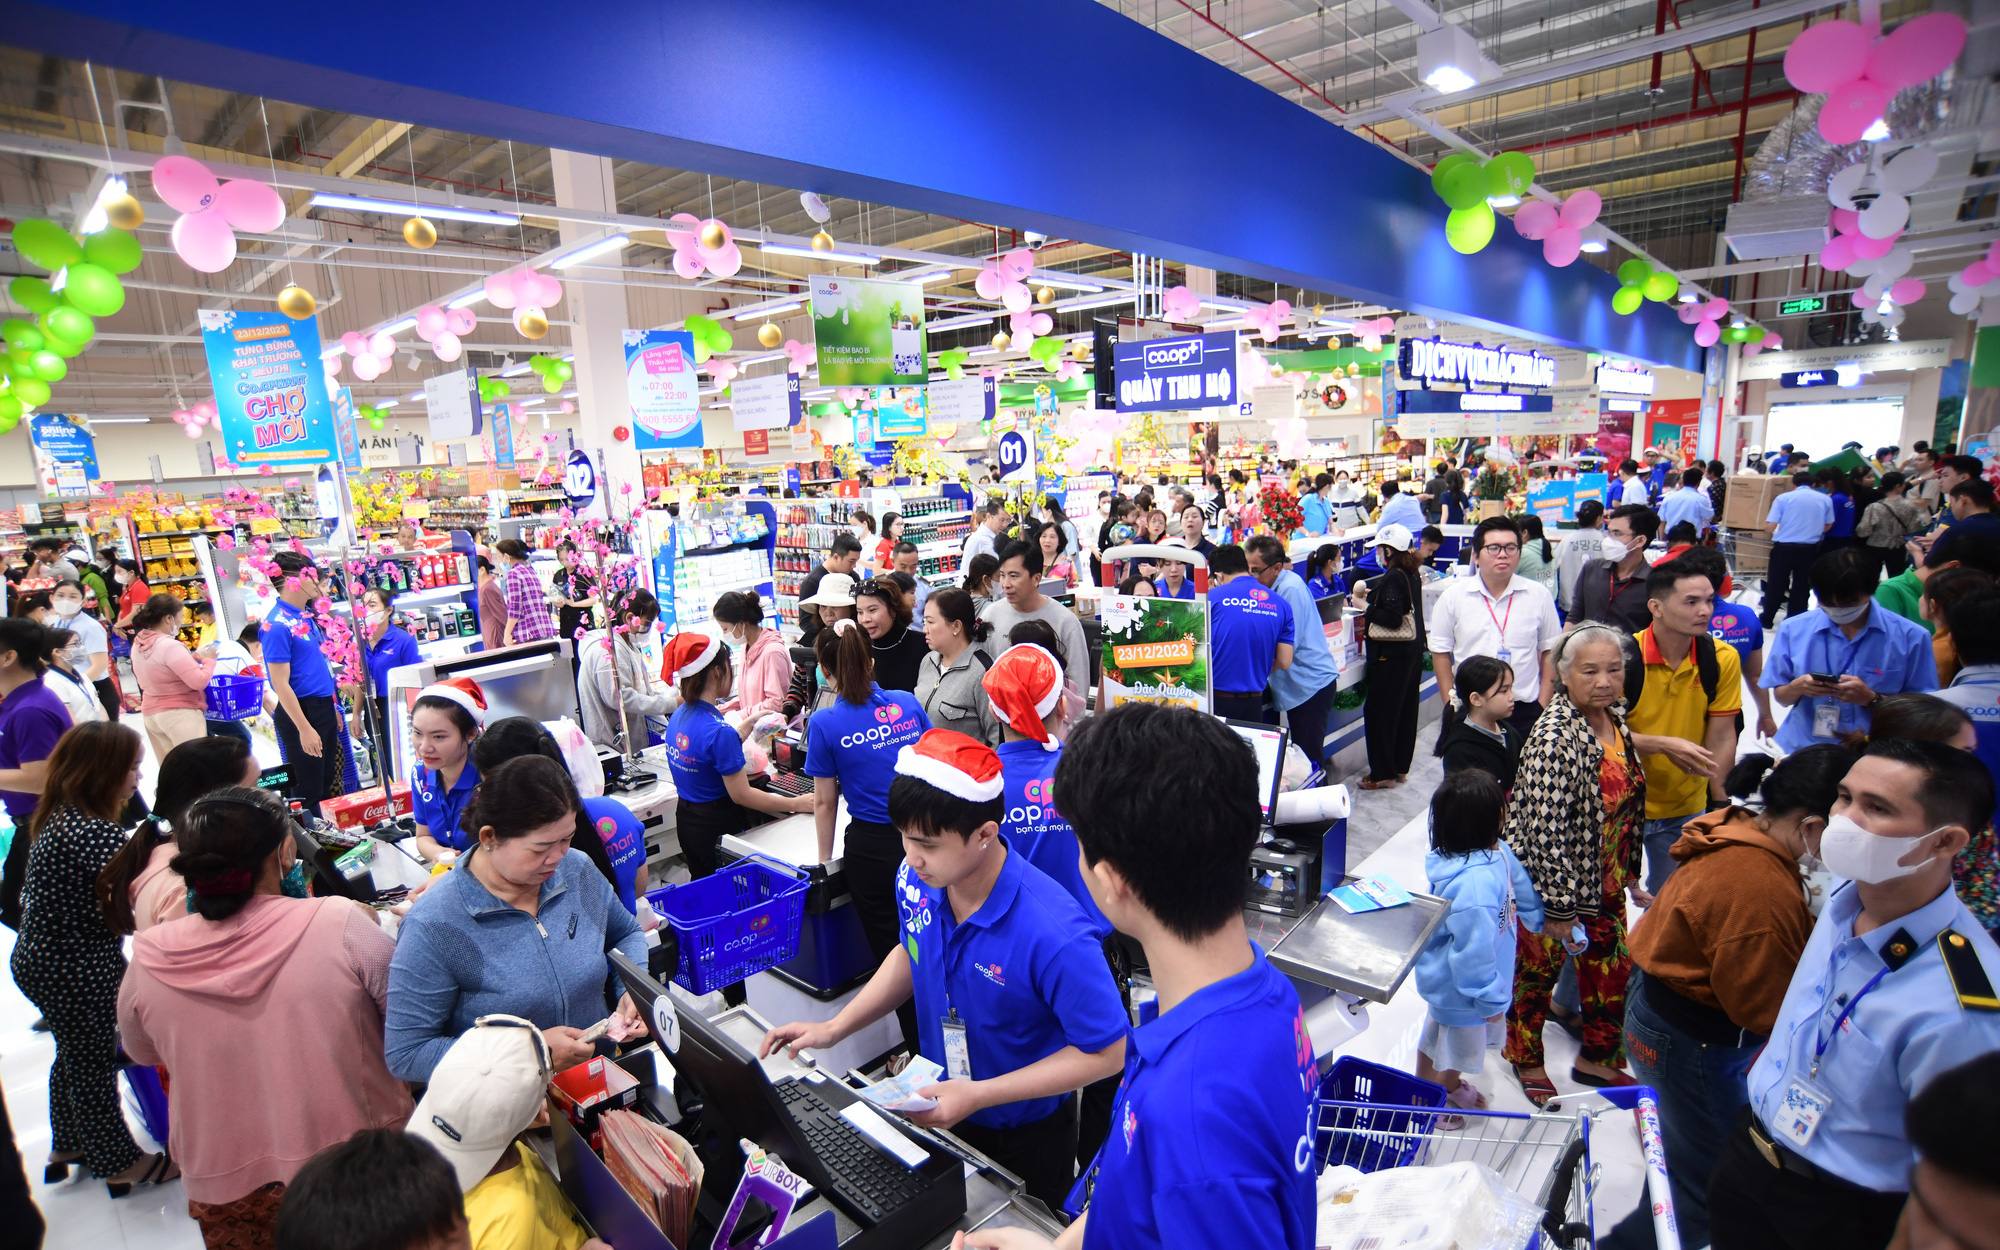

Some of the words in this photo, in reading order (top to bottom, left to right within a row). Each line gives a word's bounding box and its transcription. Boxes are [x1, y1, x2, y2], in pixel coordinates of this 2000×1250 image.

[236, 325, 287, 339] 23/12/2023
[662, 348, 678, 357] nghe
[851, 346, 864, 354] BAO
[232, 358, 258, 370] KHAI
[468, 376, 476, 392] 03
[649, 382, 674, 390] 07:00
[788, 380, 799, 392] 02
[984, 382, 994, 393] 01
[1166, 374, 1201, 401] THU
[1205, 367, 1231, 401] HỘ
[664, 391, 688, 400] 22:00
[245, 387, 307, 420] CHỢ
[662, 415, 684, 424] 5555
[685, 414, 697, 423] 68
[254, 414, 307, 448] MỚI
[372, 435, 392, 449] ĂN
[1000, 440, 1023, 465] 01
[567, 463, 594, 497] 02
[1117, 643, 1189, 661] 23/12/2023
[1133, 680, 1155, 697] Đặc
[1158, 681, 1194, 699] Quyền
[1015, 826, 1034, 835] bạn
[1049, 823, 1064, 832] mọi
[658, 1013, 675, 1037] 07
[762, 1162, 802, 1194] URBOX
